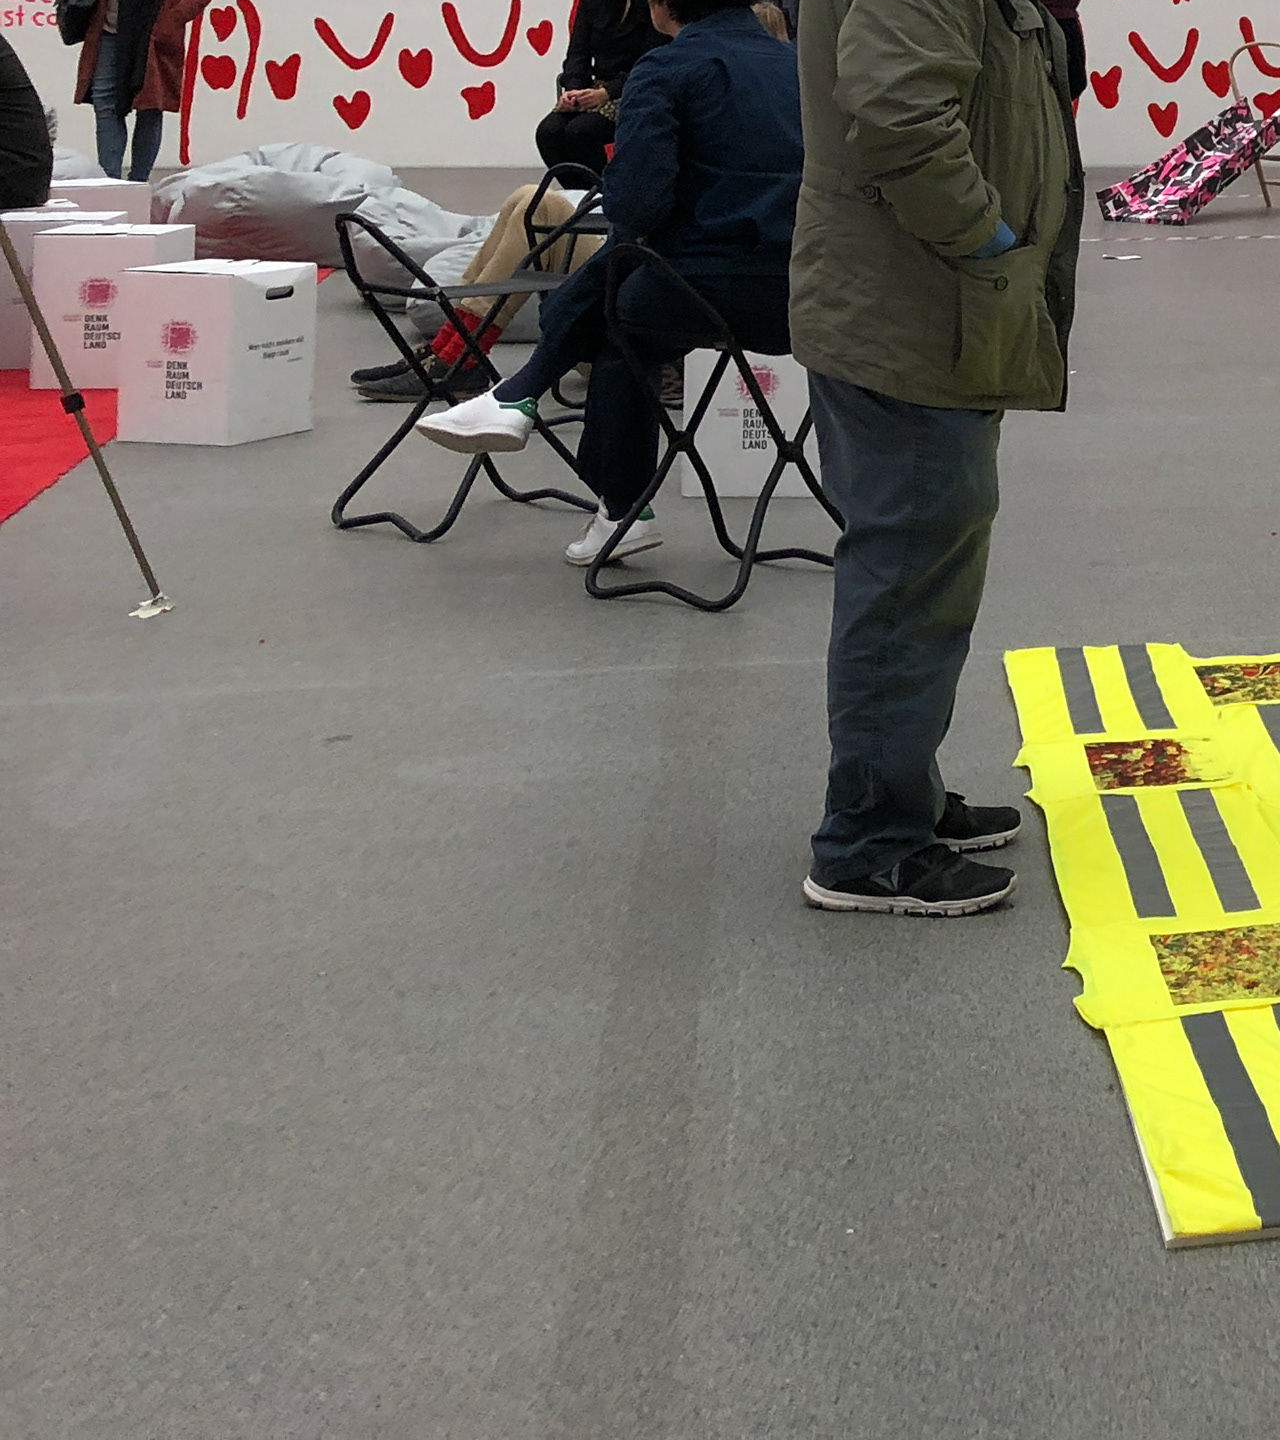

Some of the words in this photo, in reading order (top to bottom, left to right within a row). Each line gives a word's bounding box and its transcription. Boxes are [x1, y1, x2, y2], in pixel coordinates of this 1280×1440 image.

[84, 314, 109, 323] DENK
[84, 323, 110, 331] RAUM
[83, 341, 107, 350] LAND
[166, 361, 188, 370] DENK
[165, 371, 190, 380] RAUM
[165, 381, 203, 390] DEUTSCH
[165, 390, 187, 400] LAND
[742, 409, 764, 418] DEN
[742, 439, 768, 450] LAND
